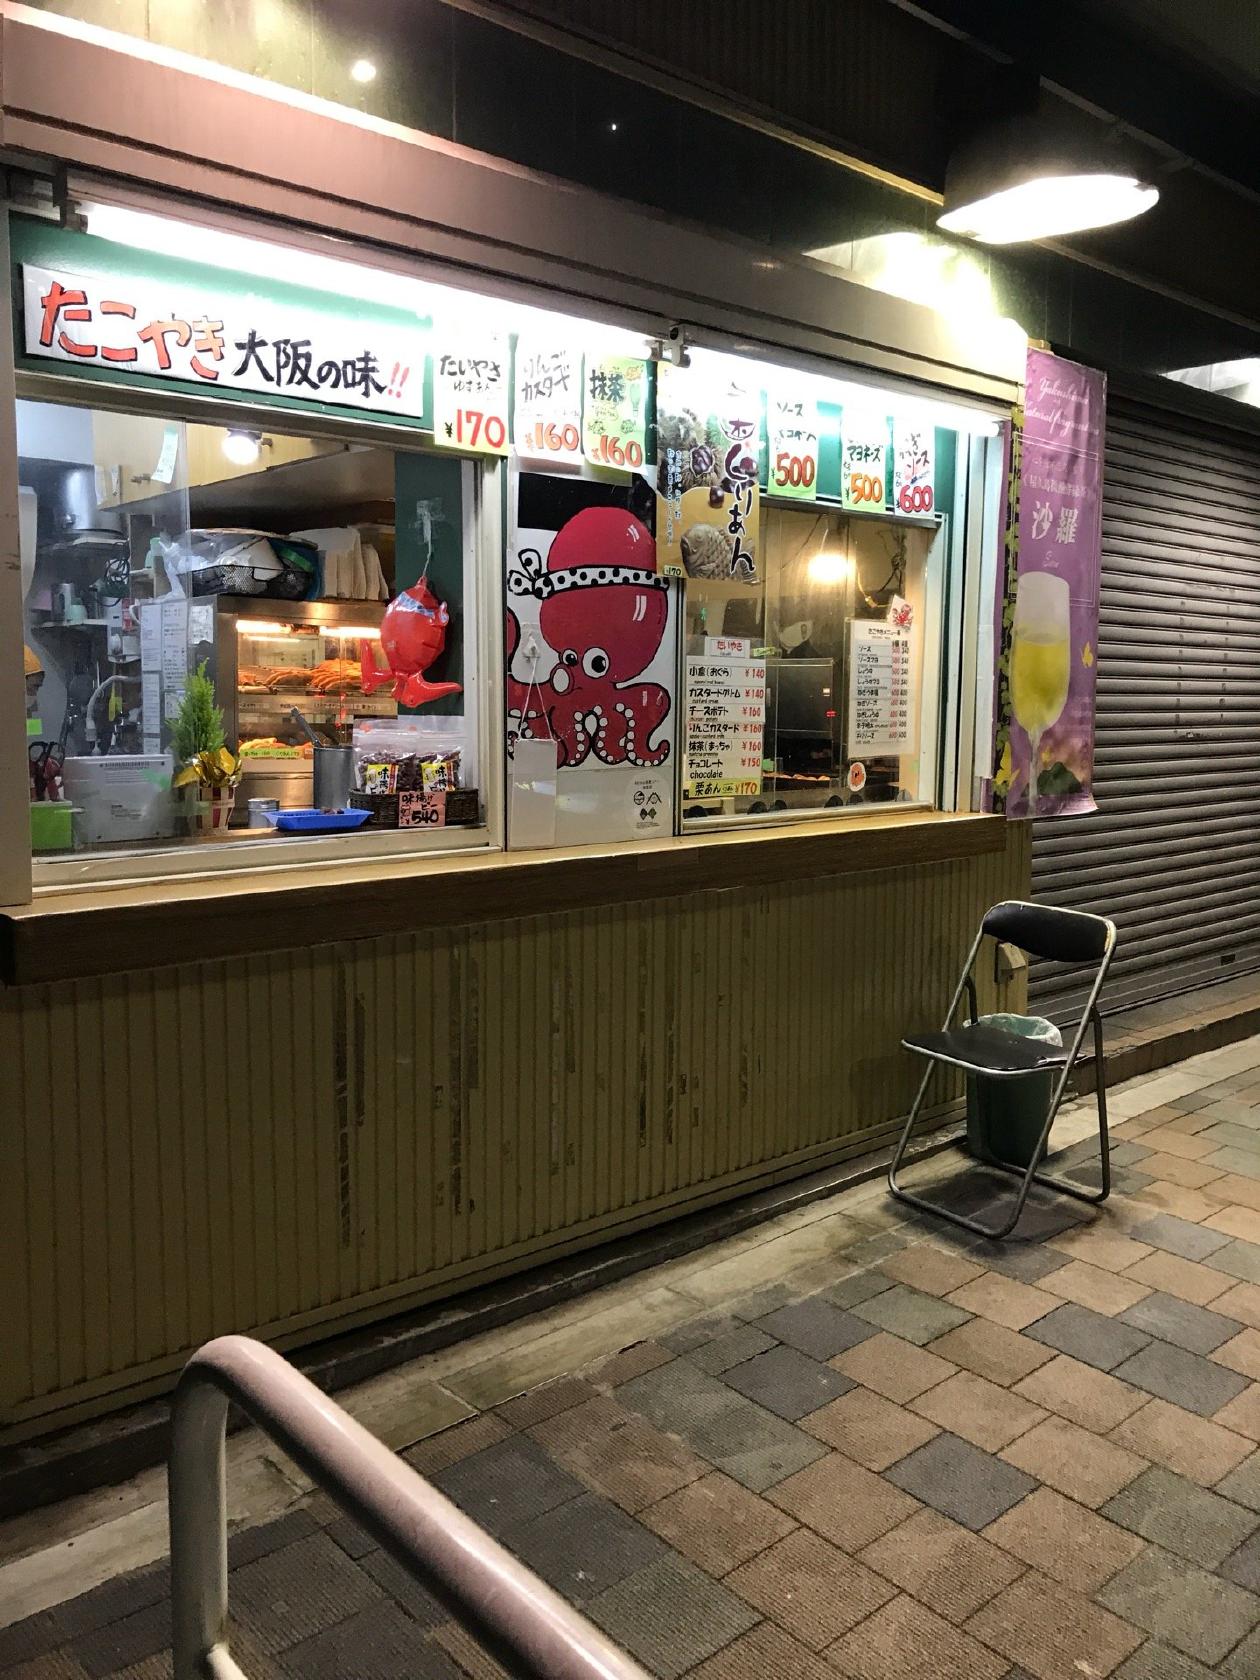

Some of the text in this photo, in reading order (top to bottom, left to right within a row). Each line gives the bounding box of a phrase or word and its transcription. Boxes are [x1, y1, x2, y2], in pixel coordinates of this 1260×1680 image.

[39, 280, 226, 380] たこやき
[440, 355, 501, 382] たいやき
[589, 369, 625, 402] 抹茶
[444, 408, 506, 449] ¥170
[524, 422, 580, 451] ¥160
[591, 434, 644, 467] ¥160
[771, 452, 816, 488] ¥500
[844, 472, 883, 504] ¥500
[895, 484, 934, 514] ¥600
[745, 689, 764, 699] ¥140
[688, 758, 761, 769] チョコレート ¥150
[690, 769, 723, 779] chocolate
